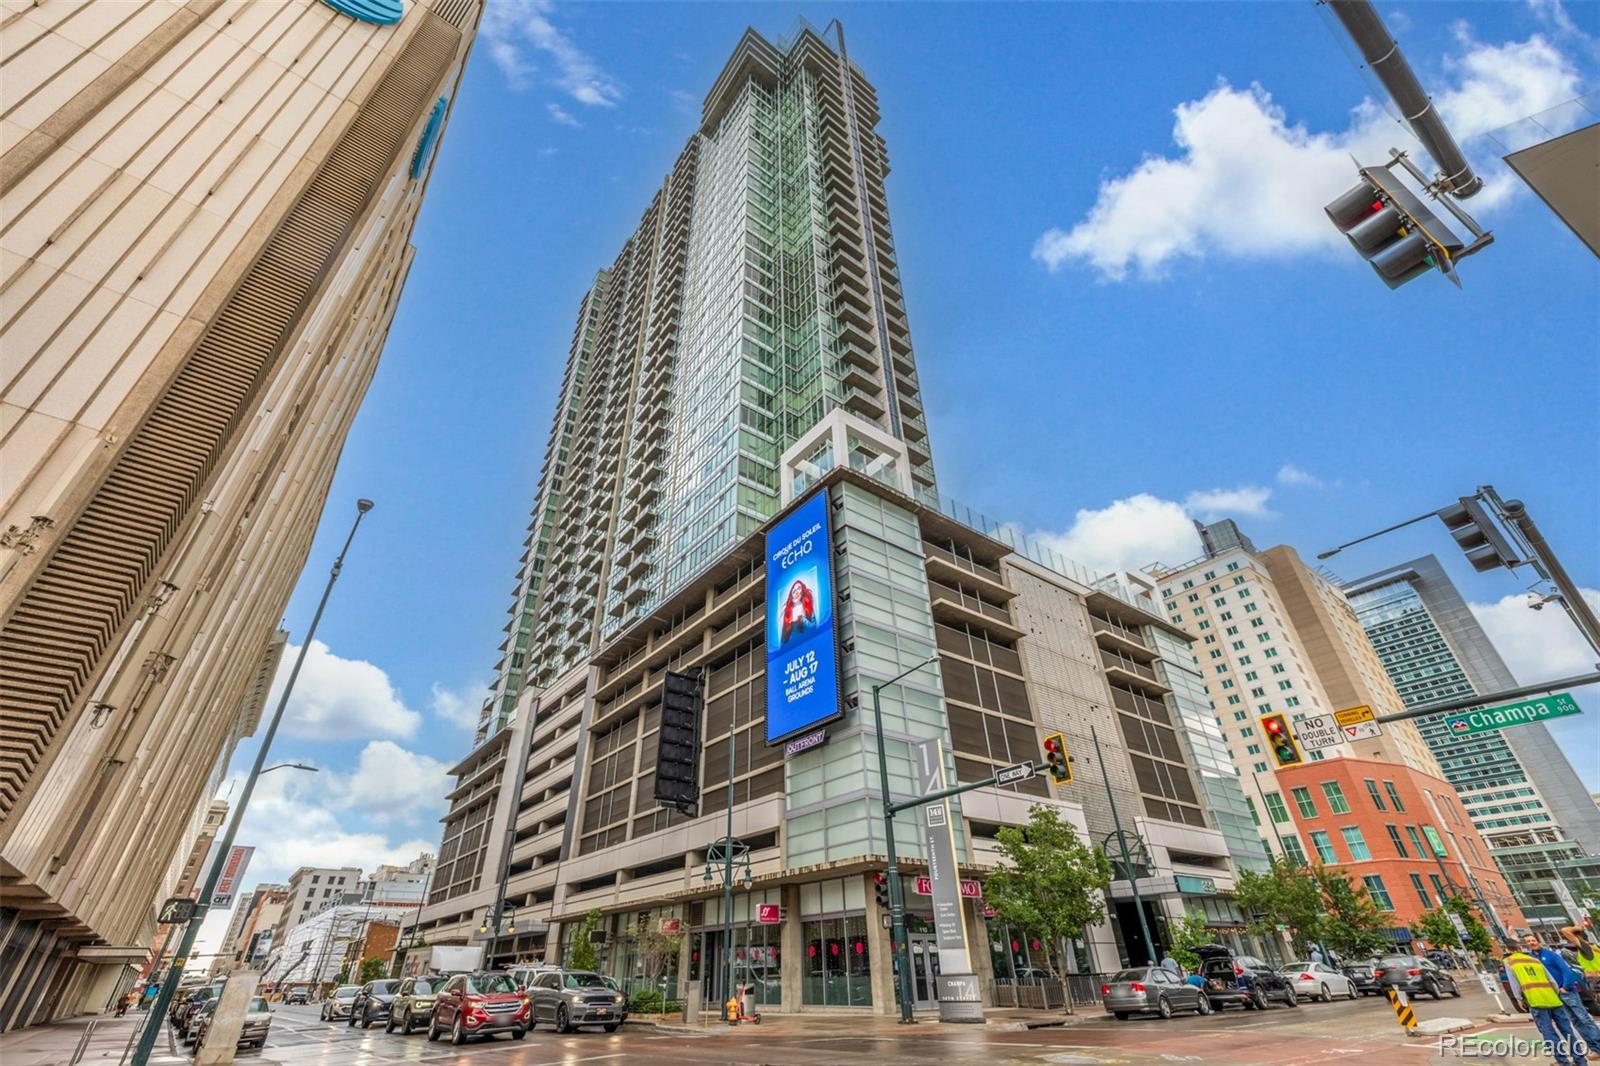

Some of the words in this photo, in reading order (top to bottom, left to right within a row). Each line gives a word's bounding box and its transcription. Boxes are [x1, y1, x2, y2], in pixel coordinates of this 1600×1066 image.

[772, 542, 793, 561] CIRQUE
[792, 535, 802, 547] DU
[801, 522, 822, 540] SOLEIL
[781, 540, 813, 569] ECHO
[784, 655, 804, 674] JULY
[806, 650, 815, 663] 12
[789, 666, 808, 684] AUG
[809, 660, 818, 674] 17
[785, 684, 797, 696] BALL
[798, 676, 816, 689] ARENA
[787, 685, 814, 703] GROUNDS
[1469, 702, 1551, 728] Champa
[1557, 703, 1575, 713] 900
[1304, 718, 1324, 730] NO
[786, 731, 824, 754] OUTFRONT
[1301, 727, 1336, 741] DOUBLE
[1310, 736, 1336, 747] TURN
[1000, 772, 1010, 781] ONE
[1011, 769, 1022, 777] WAY
[213, 894, 232, 904] art
